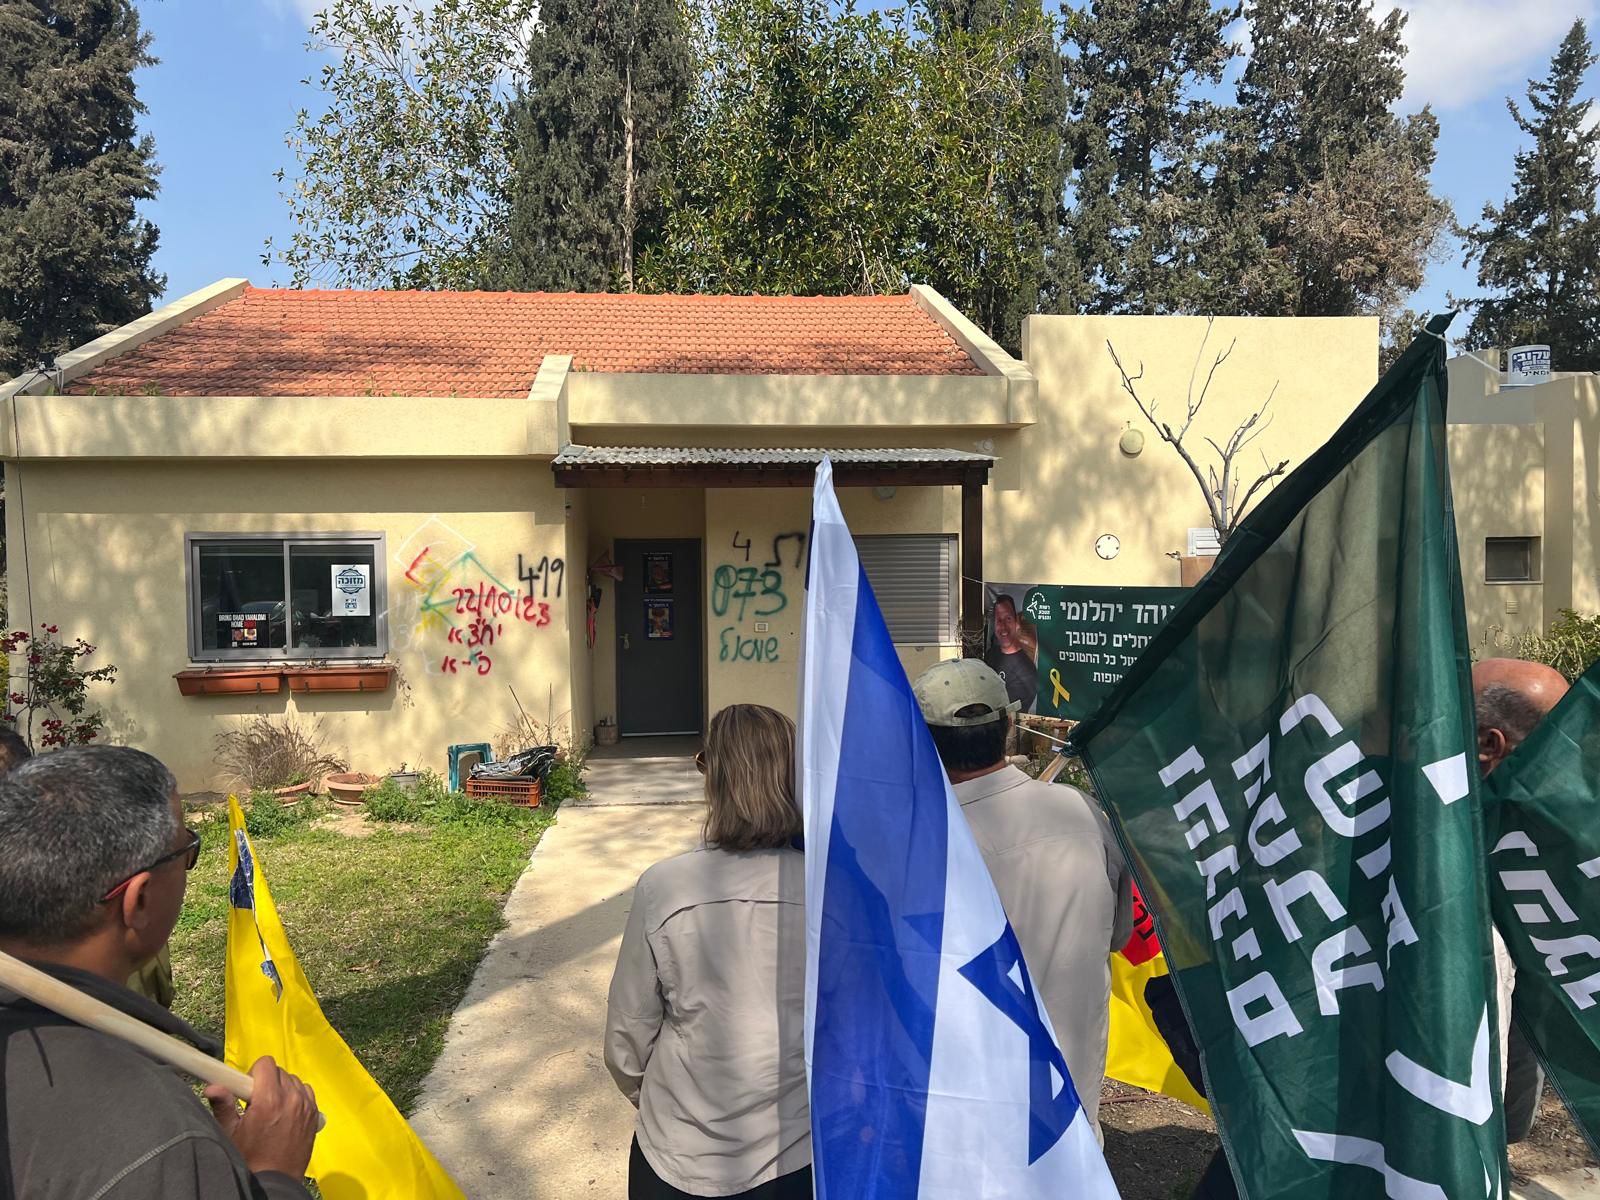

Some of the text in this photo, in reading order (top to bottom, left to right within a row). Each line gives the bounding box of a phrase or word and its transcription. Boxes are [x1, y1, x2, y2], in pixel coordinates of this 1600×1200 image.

[338, 577, 363, 585] מזוכה
[1059, 600, 1175, 625] והד יהלומי
[1065, 630, 1107, 646] לשובך
[1059, 650, 1100, 664] החטופים
[1103, 652, 1116, 665] כל
[1093, 672, 1123, 684] ופות
